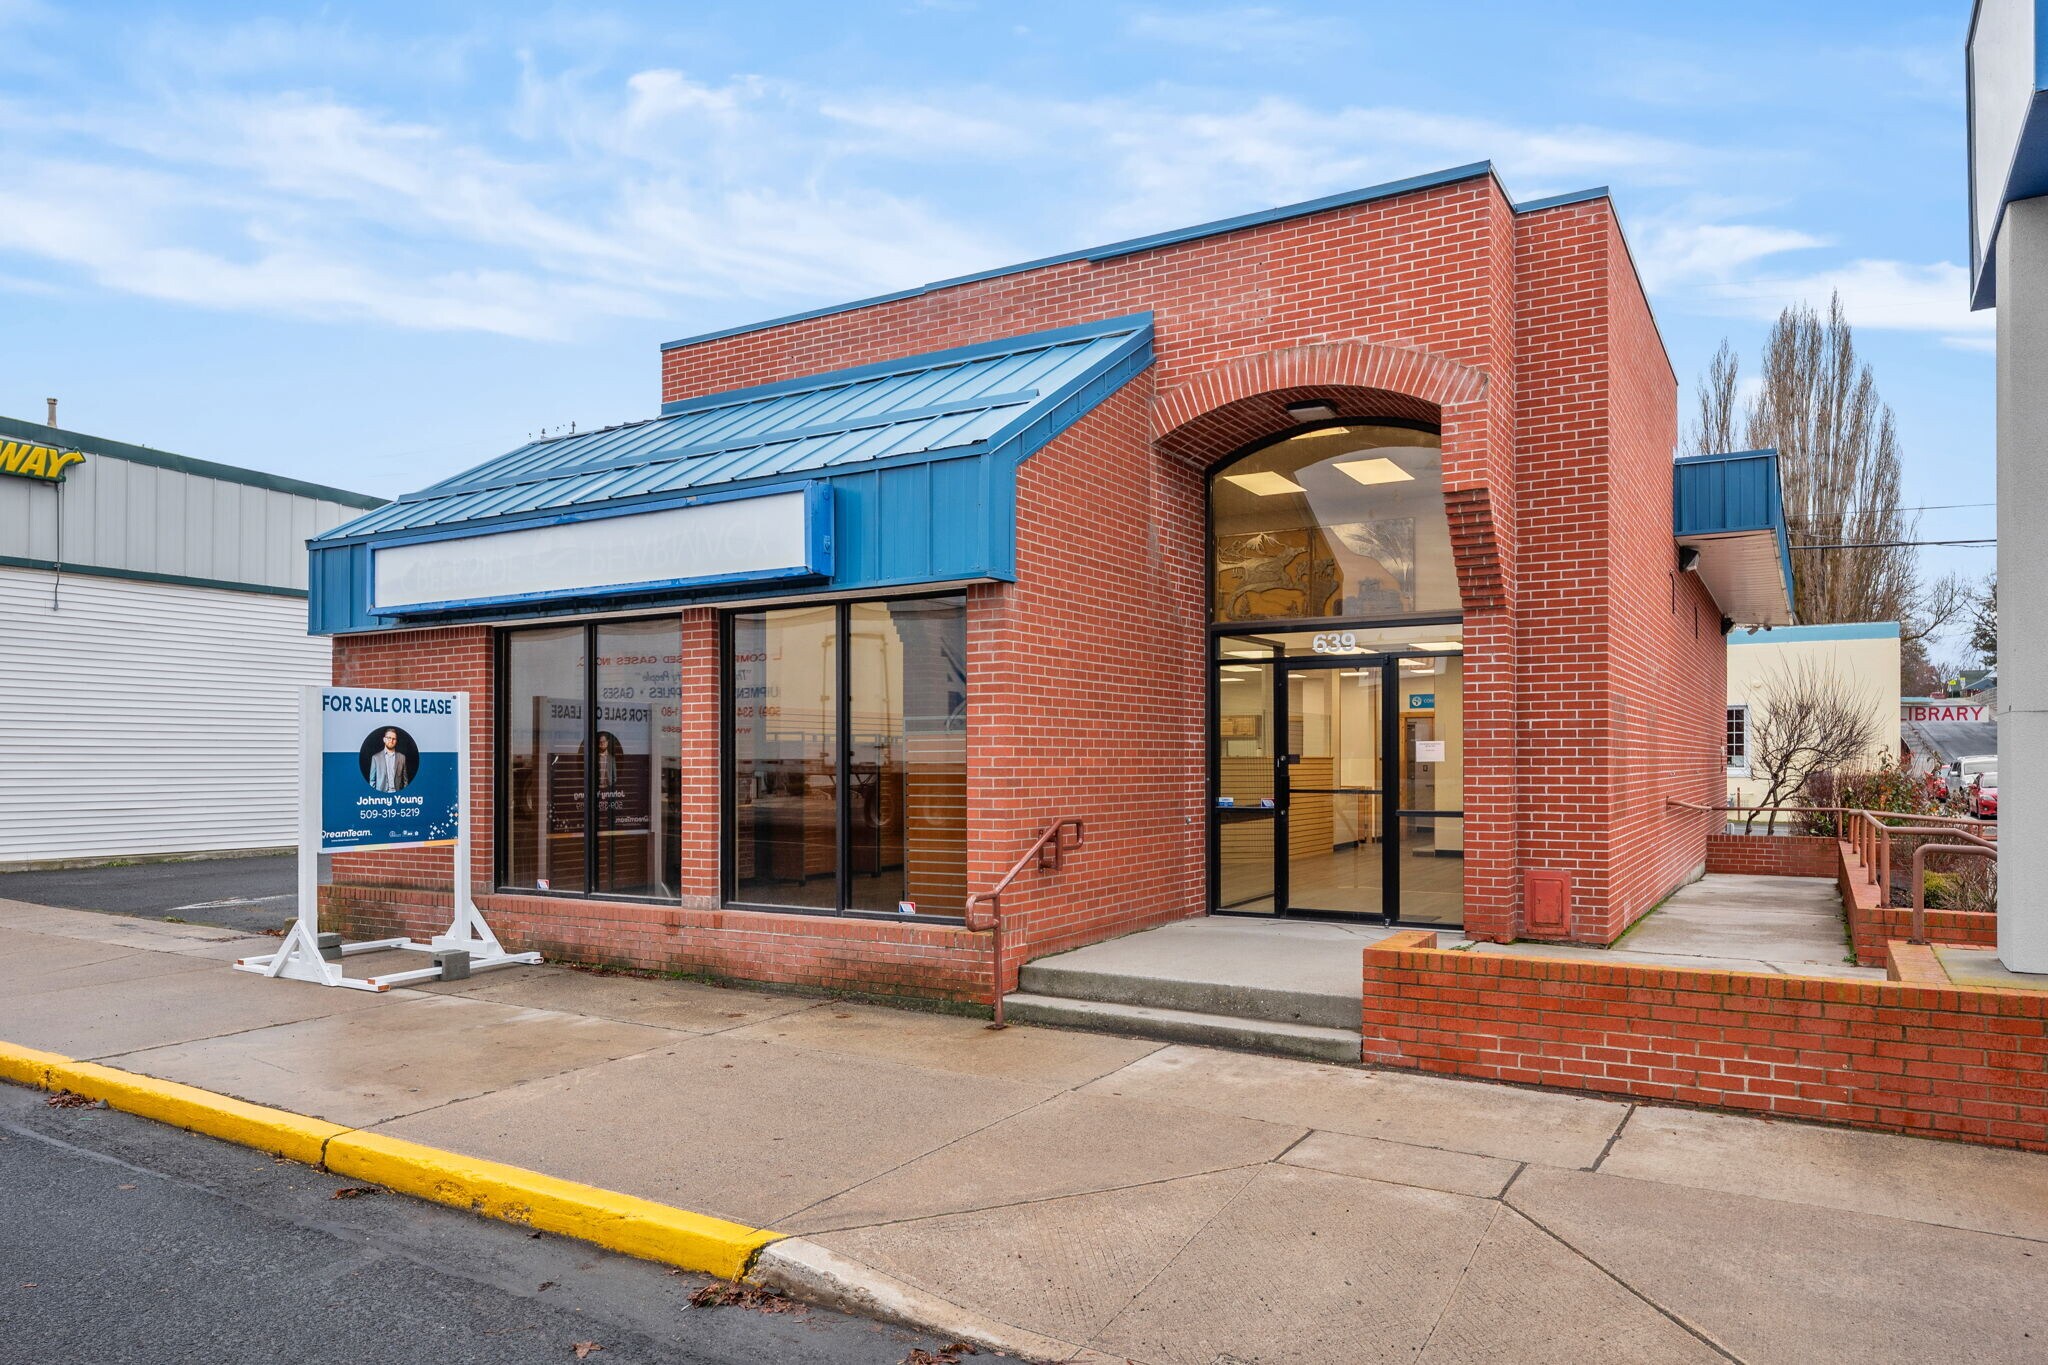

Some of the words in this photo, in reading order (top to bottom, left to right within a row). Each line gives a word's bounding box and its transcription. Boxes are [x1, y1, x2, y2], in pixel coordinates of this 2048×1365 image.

[0, 440, 85, 478] WAY
[1312, 632, 1356, 654] 639
[322, 694, 352, 713] FOR
[355, 696, 389, 713] SALE
[391, 697, 411, 714] OR
[414, 698, 452, 715] LEASE
[356, 796, 393, 807] Johnny
[394, 795, 424, 806] Young
[360, 808, 420, 820] 509-319-5219
